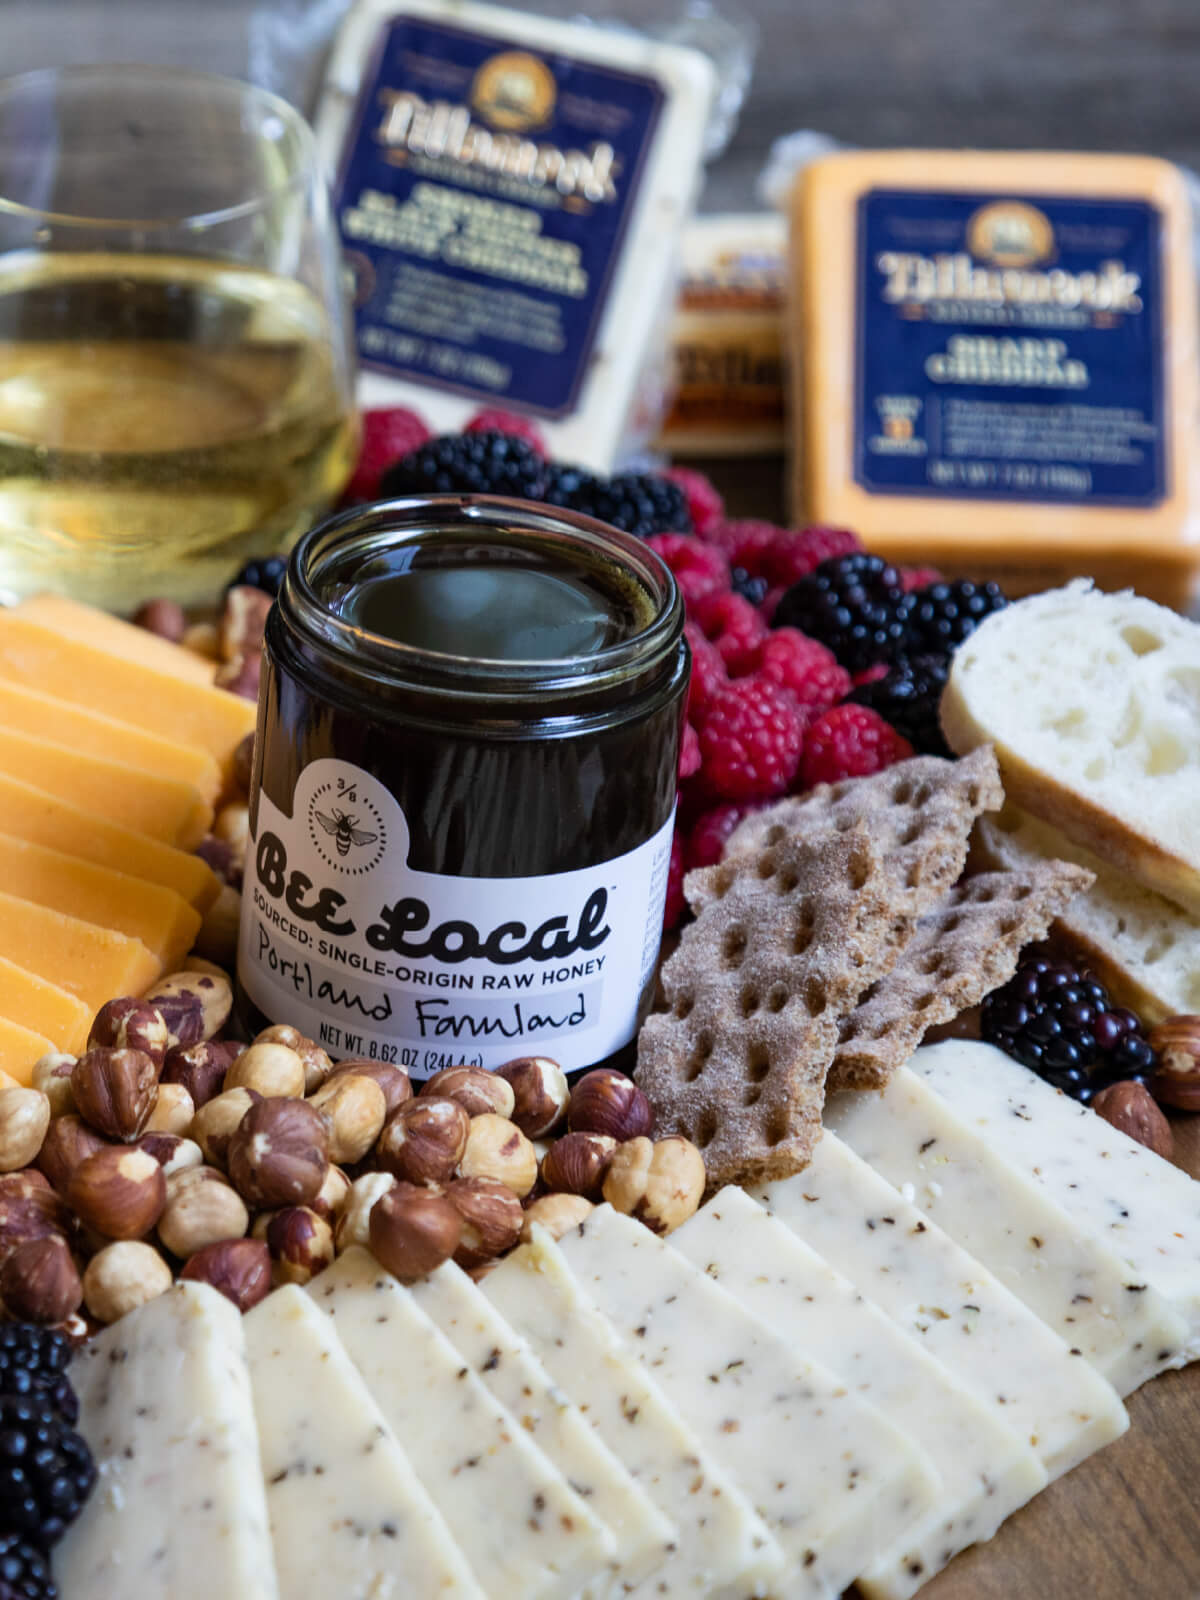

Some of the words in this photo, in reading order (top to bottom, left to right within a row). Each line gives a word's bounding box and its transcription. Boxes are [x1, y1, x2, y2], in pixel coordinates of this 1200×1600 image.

[878, 253, 1143, 314] Tillamook
[337, 777, 357, 803] 3/8
[254, 888, 313, 949] SOURCED:
[318, 940, 474, 989] SINGLE-ORIGIN
[482, 973, 534, 990] RAW
[542, 956, 606, 985] HONEY
[365, 887, 611, 965] Local
[257, 921, 392, 1021] Portland
[319, 1022, 342, 1047] NET
[345, 1033, 365, 1056] WT.
[369, 1041, 398, 1064] 8.62
[401, 1048, 419, 1068] OZ
